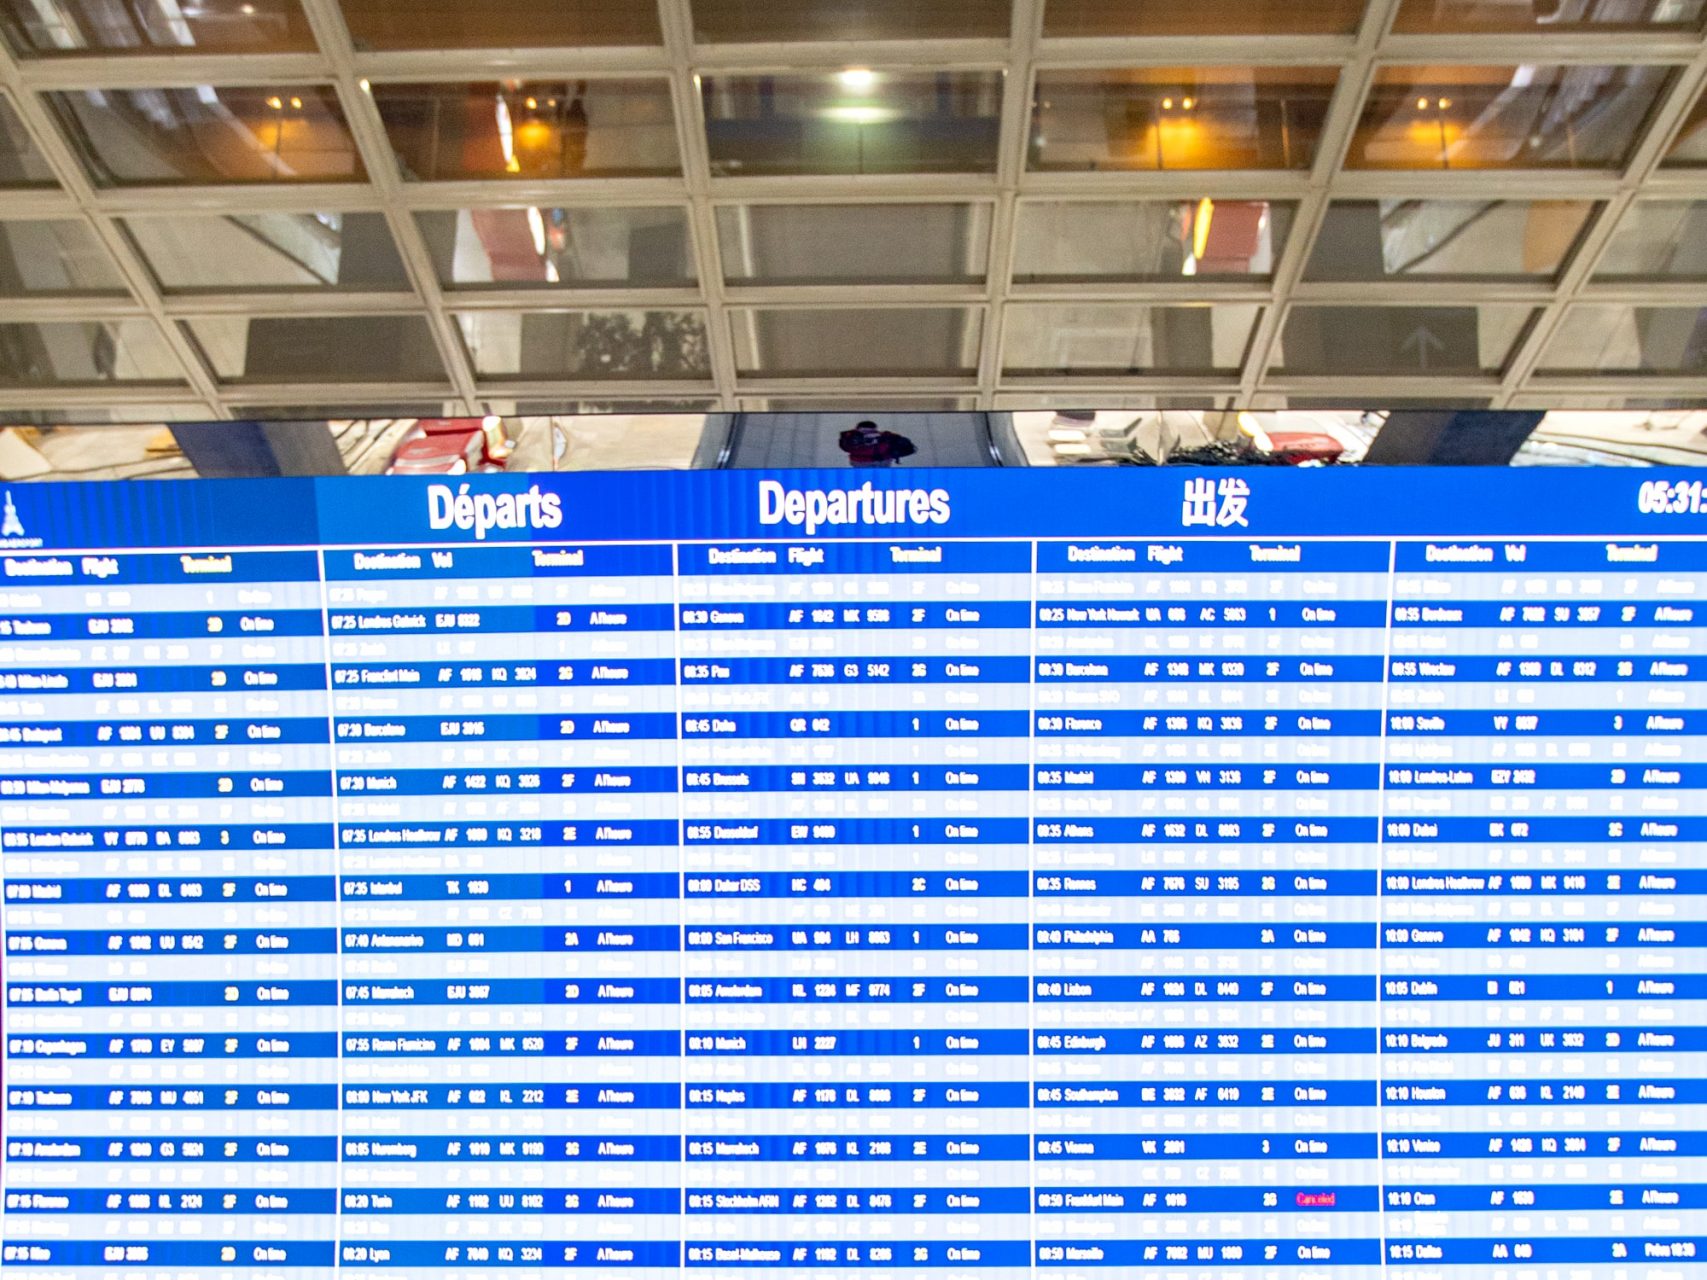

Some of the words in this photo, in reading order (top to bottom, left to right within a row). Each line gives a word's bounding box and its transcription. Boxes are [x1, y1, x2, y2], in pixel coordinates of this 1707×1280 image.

[427, 483, 563, 540] Départs
[759, 480, 951, 535] Departures
[1182, 477, 1251, 527] 出发
[708, 547, 777, 564] Destination
[788, 547, 824, 567] Flight
[889, 546, 942, 563] Terminal
[1067, 545, 1136, 562] Destination
[1147, 544, 1184, 565] Flight
[1249, 544, 1301, 562] Terminal
[739, 878, 761, 892] DSS
[715, 931, 733, 945] San
